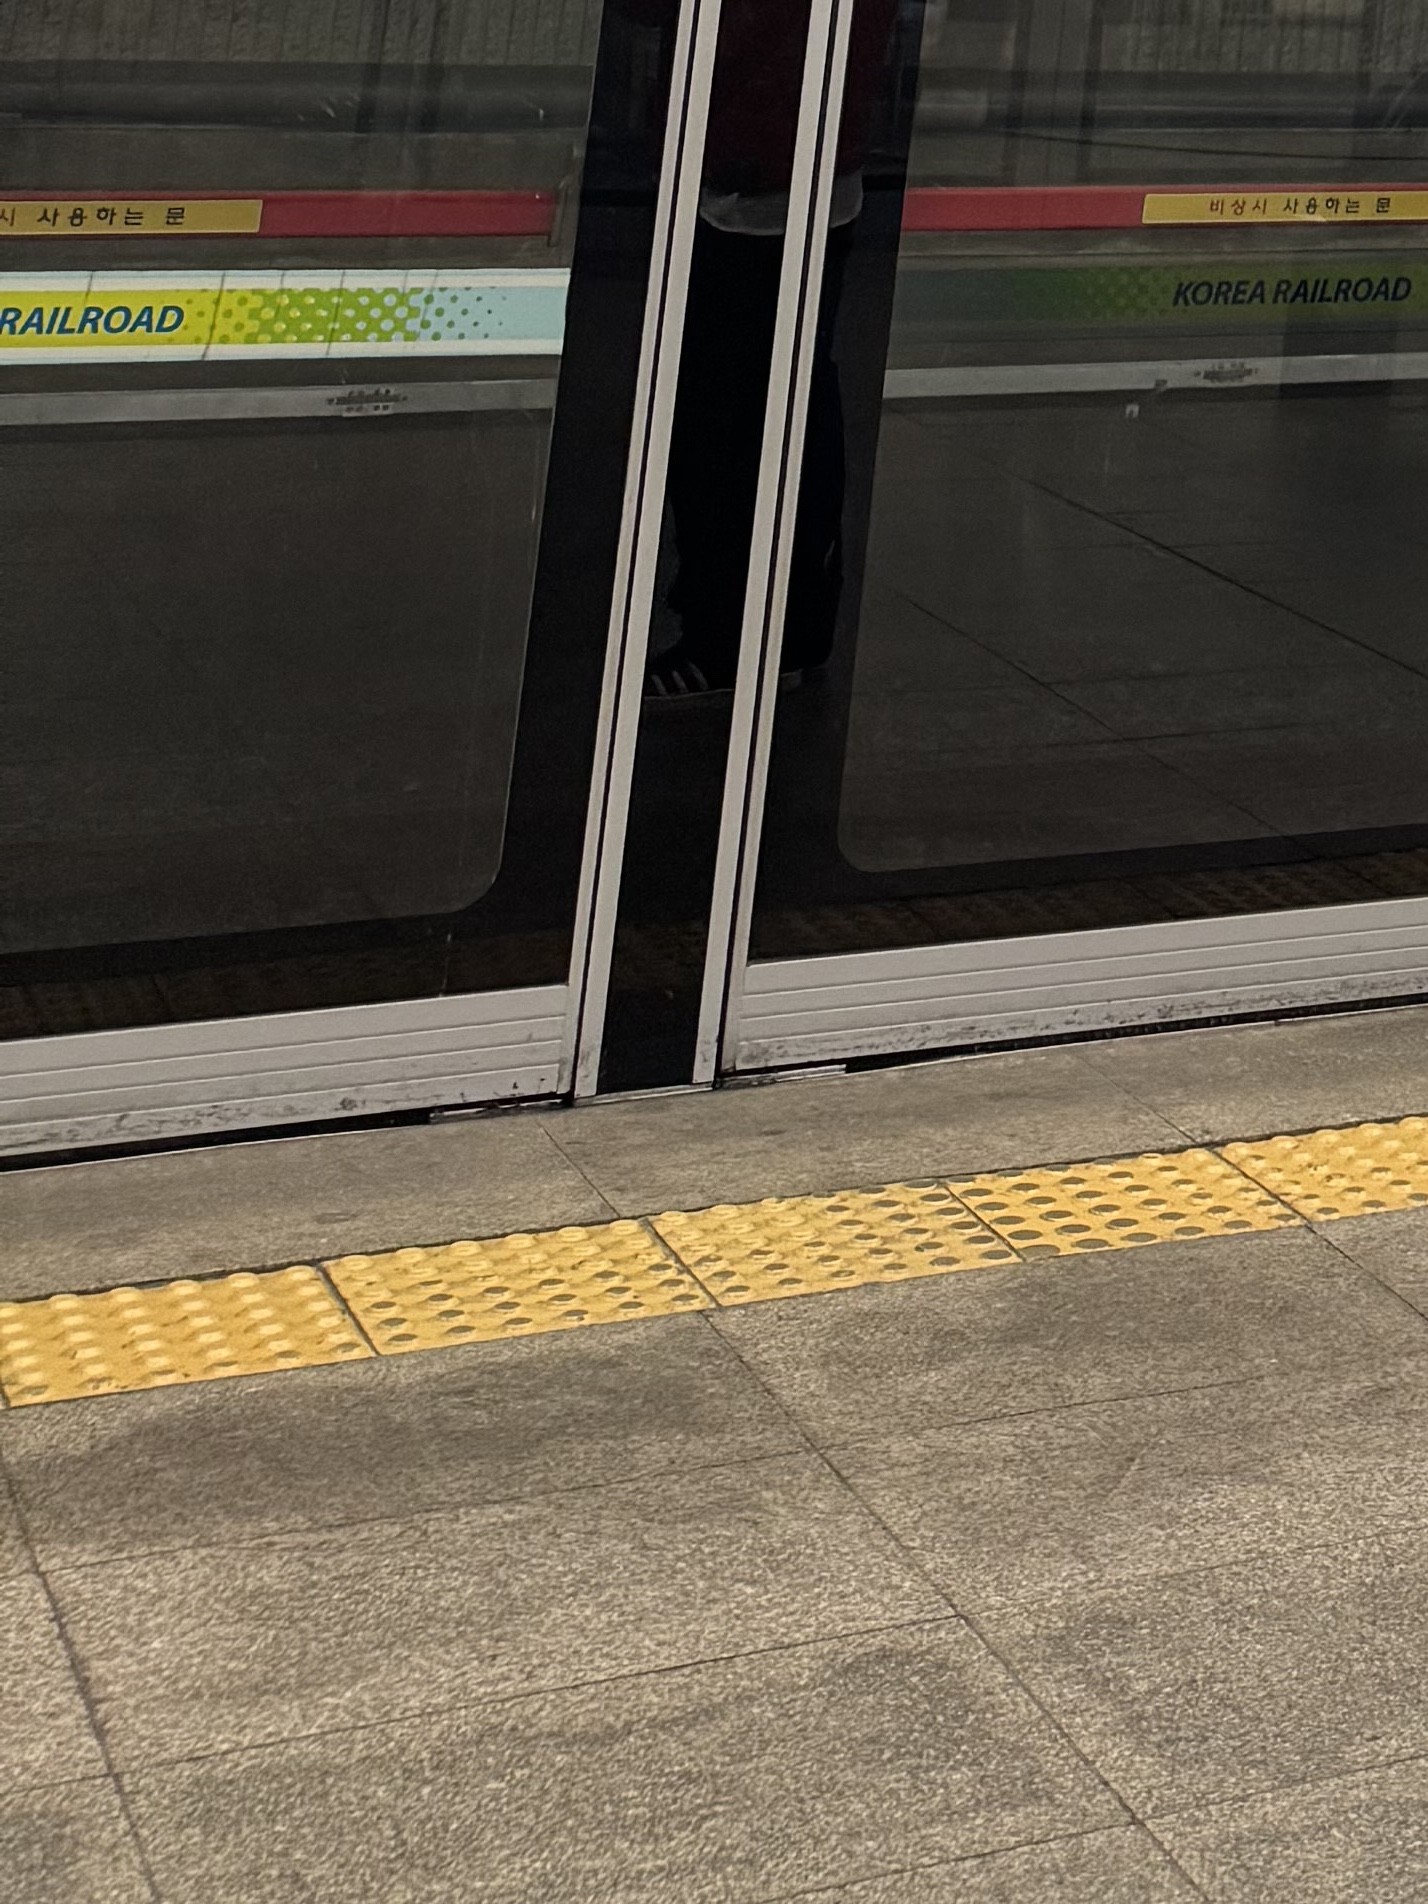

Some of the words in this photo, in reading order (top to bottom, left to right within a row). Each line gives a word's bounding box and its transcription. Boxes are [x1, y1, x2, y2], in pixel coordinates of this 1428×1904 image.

[37, 206, 144, 227] 사용하는
[165, 206, 186, 226] 문
[1209, 199, 1269, 215] 비상시
[1282, 197, 1361, 215] 사용하는
[1375, 197, 1392, 214] 문
[1172, 280, 1266, 307] KOREA
[1272, 277, 1412, 304] RAILROAD
[0, 305, 185, 335] RAILROAD
